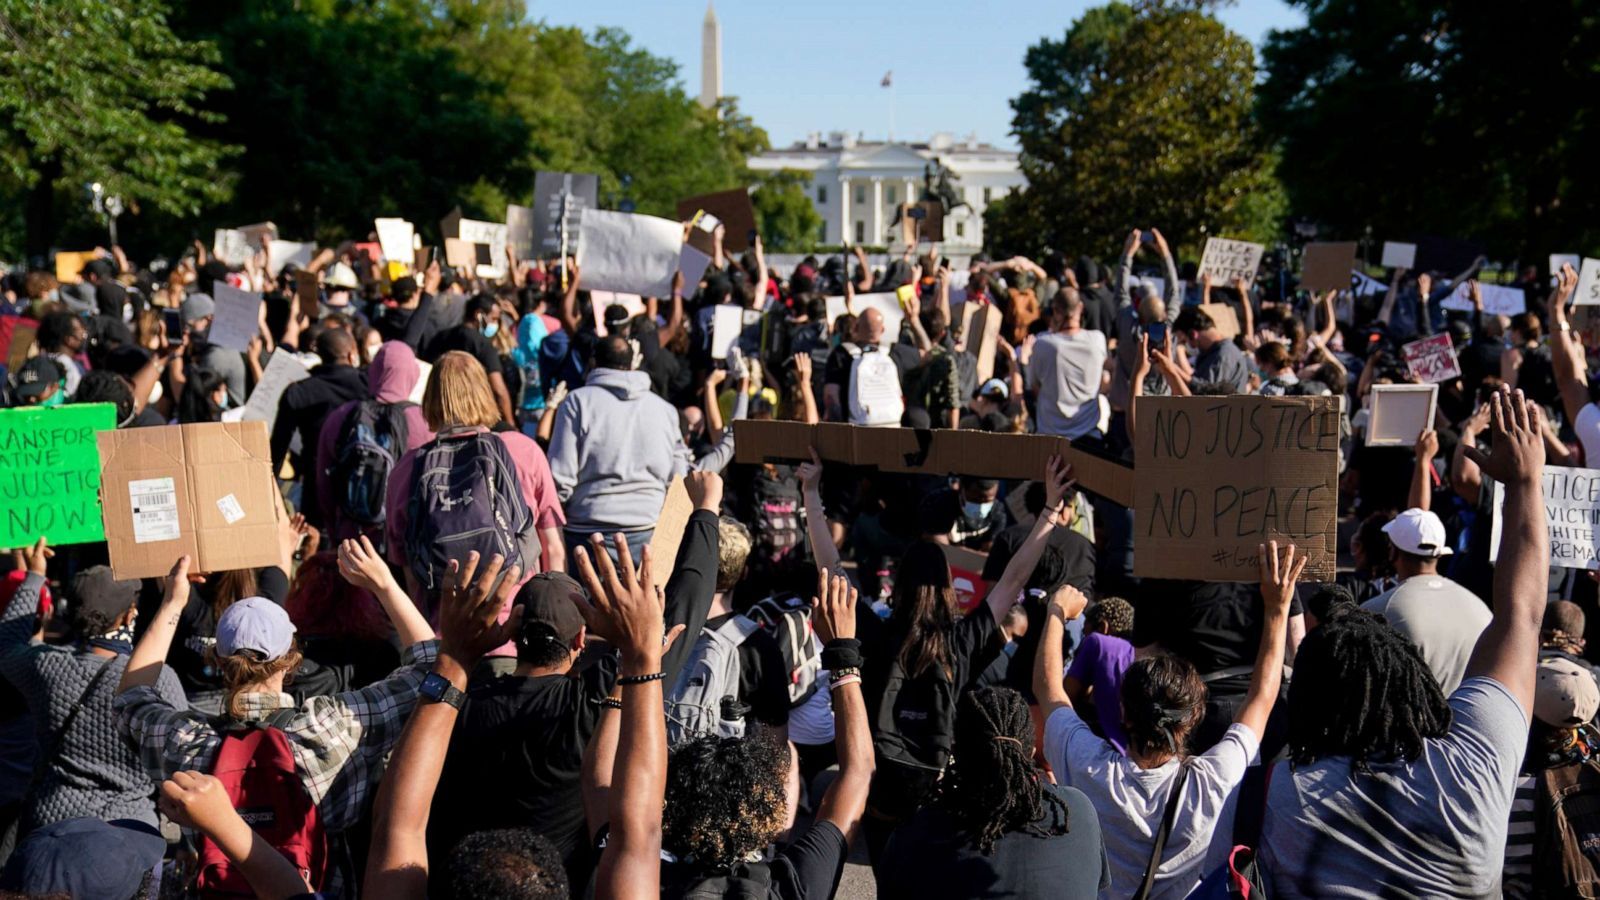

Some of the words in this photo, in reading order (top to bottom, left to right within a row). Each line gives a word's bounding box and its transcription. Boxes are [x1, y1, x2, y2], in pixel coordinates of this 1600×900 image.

[1204, 253, 1251, 269] LIVES
[1209, 240, 1255, 255] BLACK
[1153, 408, 1191, 459] NO
[1205, 403, 1338, 458] JUSTICE
[3, 468, 99, 499] JUSTIC
[8, 502, 85, 539] NOW
[1149, 486, 1197, 538] NO
[1213, 483, 1328, 539] PEACE
